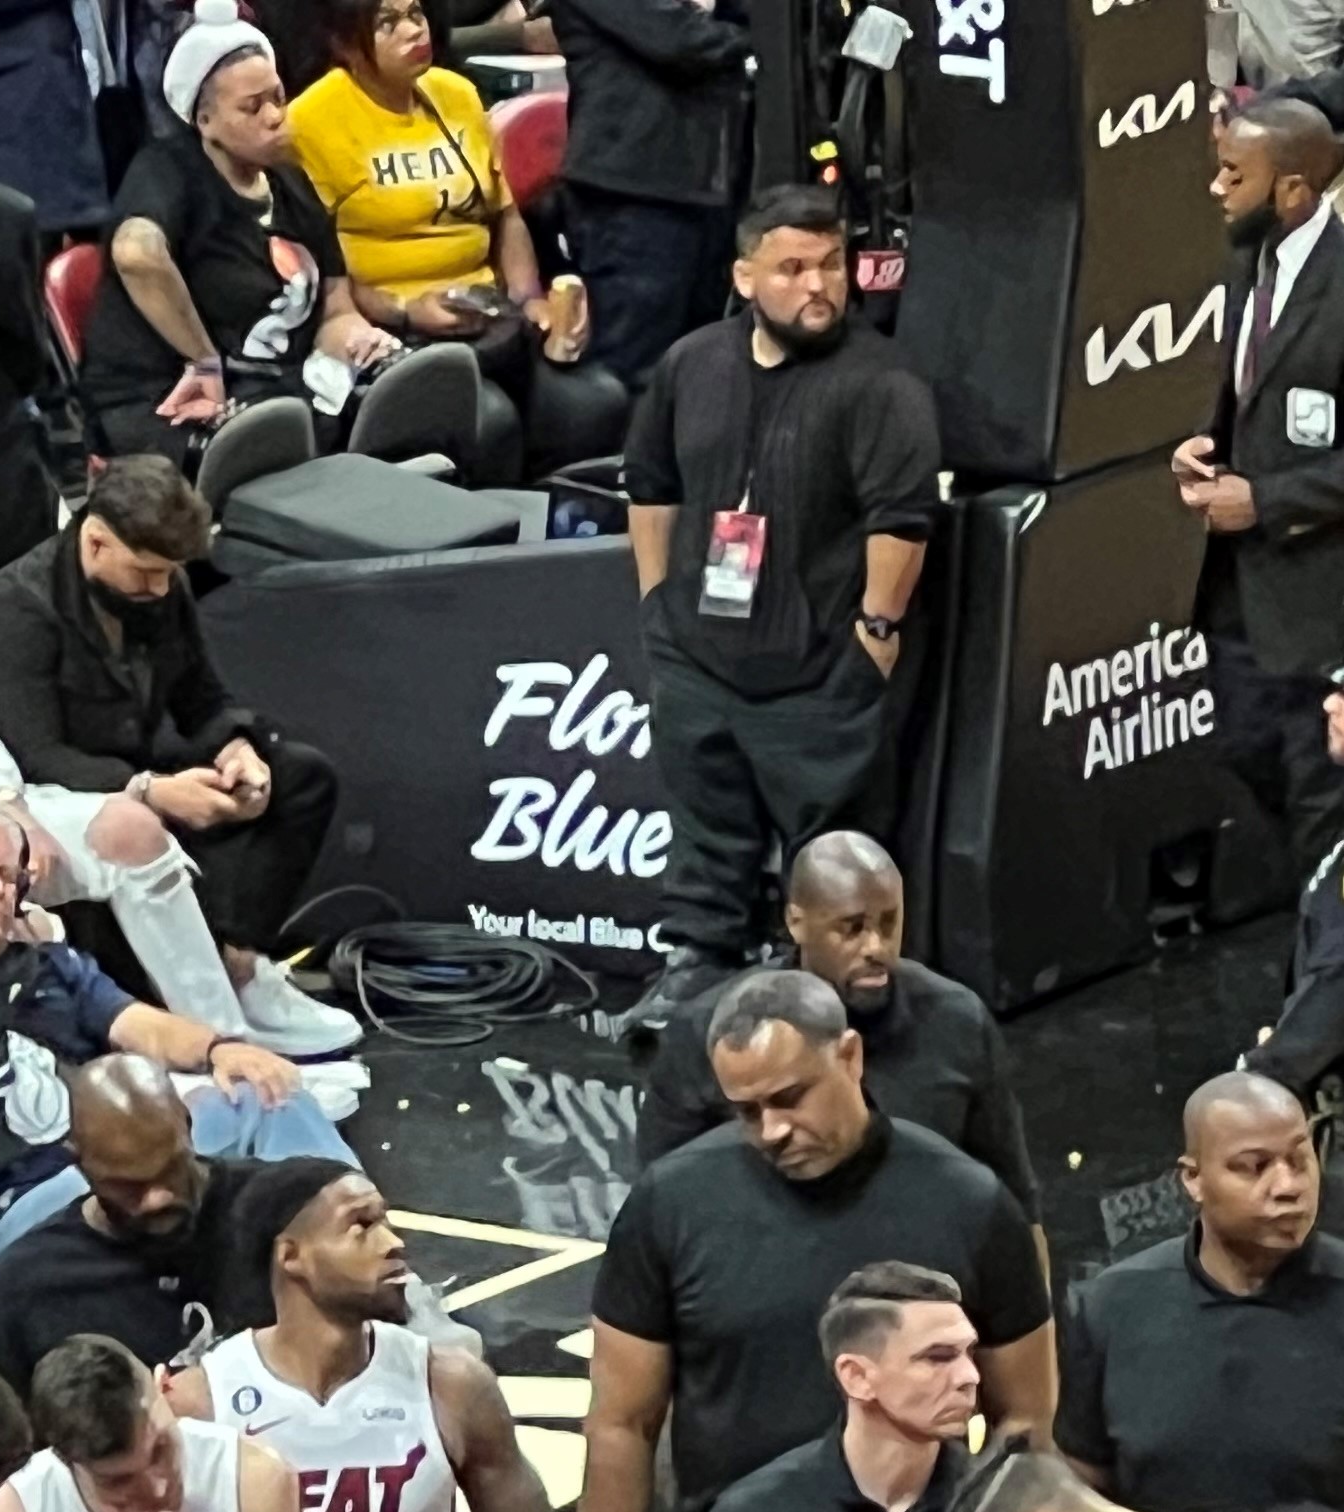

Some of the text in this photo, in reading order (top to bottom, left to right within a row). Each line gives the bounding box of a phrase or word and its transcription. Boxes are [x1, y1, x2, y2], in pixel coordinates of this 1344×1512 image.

[1098, 79, 1196, 149] KIA
[1084, 284, 1226, 386] KIA
[1084, 688, 1215, 780] Airline
[470, 769, 674, 878] Blue
[467, 903, 524, 937] Your
[527, 908, 586, 944] local
[589, 916, 644, 950] Blue
